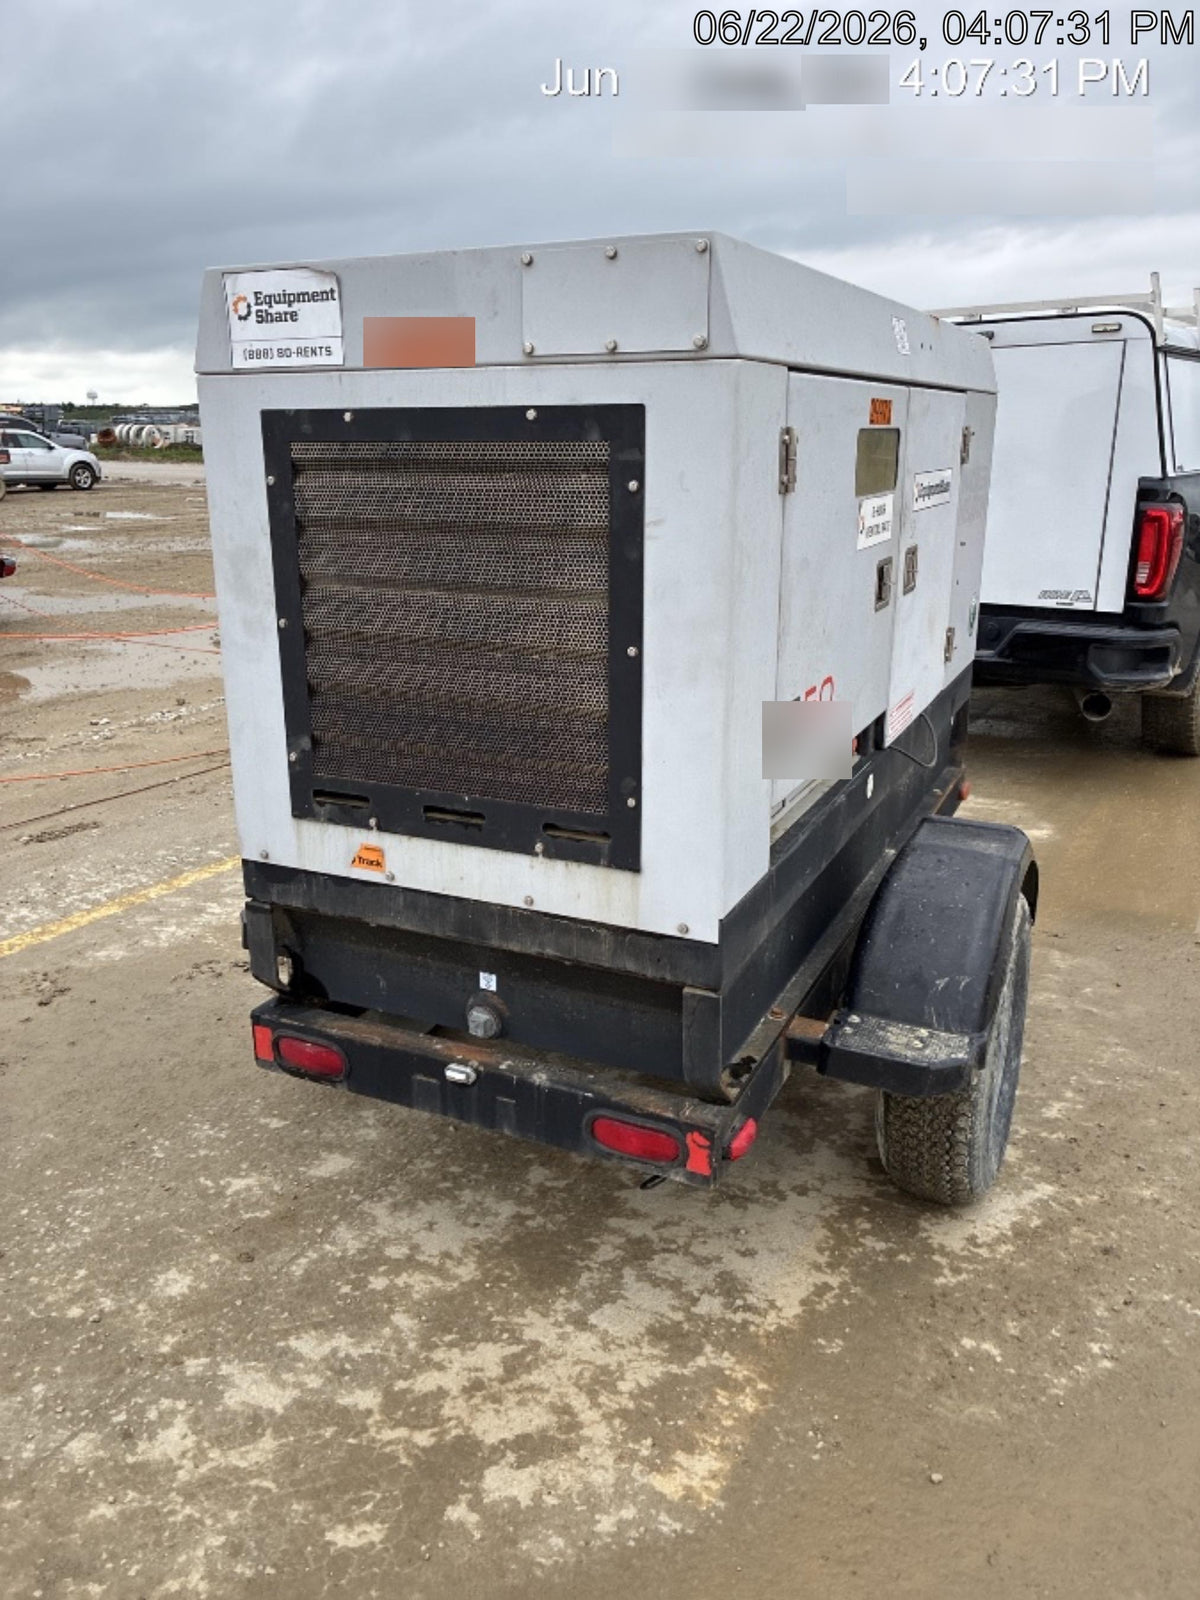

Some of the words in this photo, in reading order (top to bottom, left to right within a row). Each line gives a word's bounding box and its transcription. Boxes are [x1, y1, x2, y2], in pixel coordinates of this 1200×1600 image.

[253, 287, 336, 308] Equipment
[255, 308, 299, 325] Share
[243, 347, 274, 361] (888)
[358, 855, 383, 868] Track
